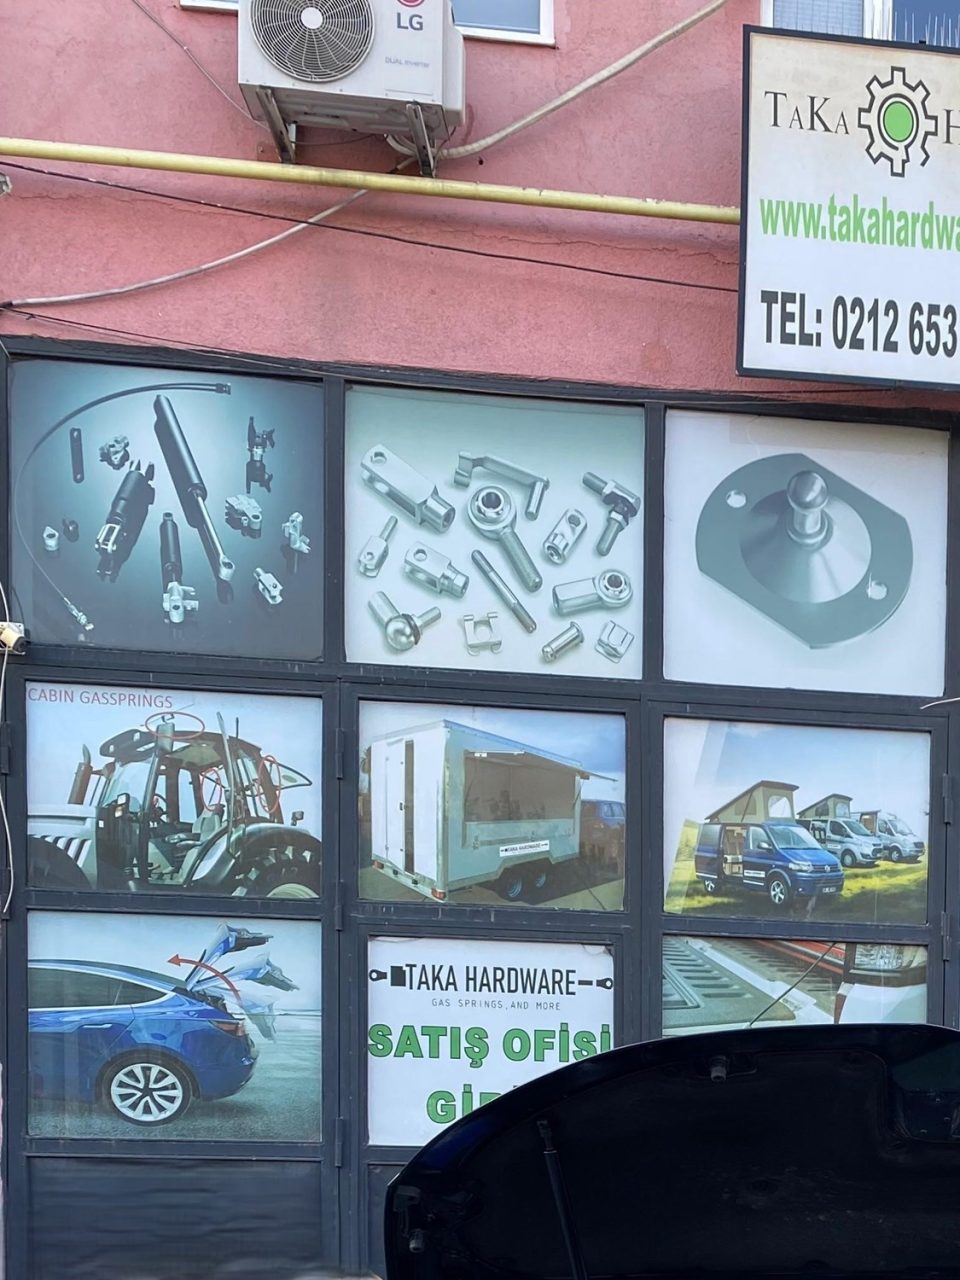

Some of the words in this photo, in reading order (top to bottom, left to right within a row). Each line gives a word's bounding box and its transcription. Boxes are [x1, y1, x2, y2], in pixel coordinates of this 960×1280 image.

[397, 12, 424, 31] LG
[761, 290, 823, 347] TEL:
[832, 296, 899, 353] 0212
[909, 302, 958, 358] 653
[28, 688, 74, 703] CABIN
[79, 690, 173, 708] GASSPRINGS
[405, 963, 458, 992] TAKA
[465, 966, 577, 995] HARDWARE
[432, 998, 451, 1007] GAS
[536, 1002, 561, 1011] MORE
[368, 1023, 490, 1068] SATIŞ
[502, 1022, 612, 1062] OFİSİ
